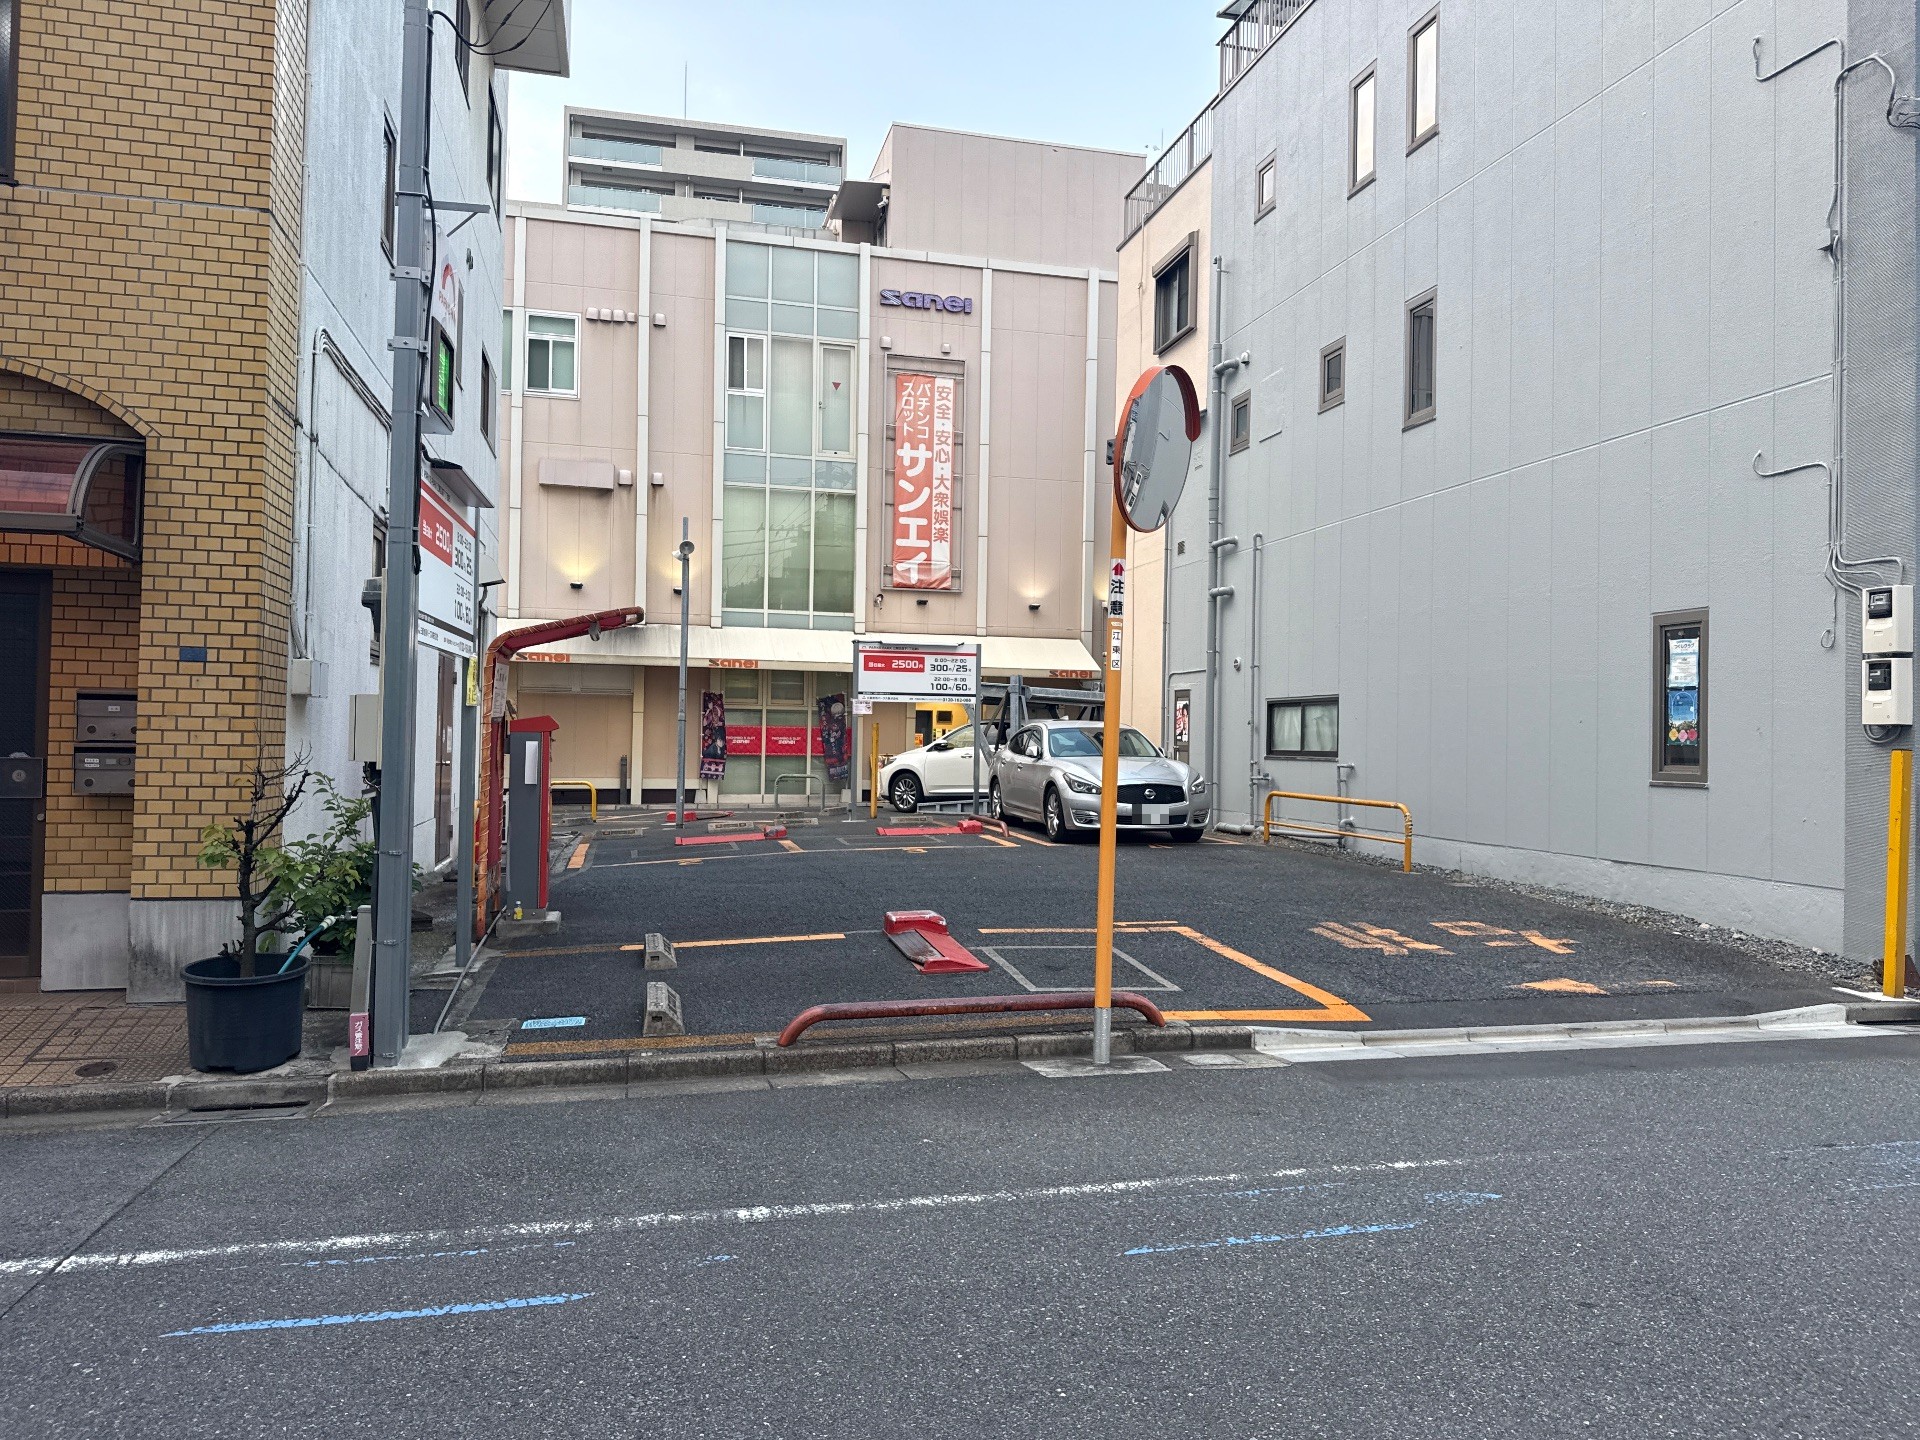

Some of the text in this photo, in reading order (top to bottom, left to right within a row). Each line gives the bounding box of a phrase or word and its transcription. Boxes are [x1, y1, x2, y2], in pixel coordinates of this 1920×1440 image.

[880, 289, 973, 314] sanei
[901, 381, 915, 437] スロット
[916, 382, 932, 439] パチンコ
[932, 385, 952, 544] 安全・安心・大衆娯楽
[895, 441, 933, 585] サンエイ
[1109, 578, 1125, 616] 注意
[516, 652, 571, 663] sanei
[709, 659, 759, 669] sanei
[1112, 631, 1121, 669] 江東区
[1049, 670, 1093, 679] sanei
